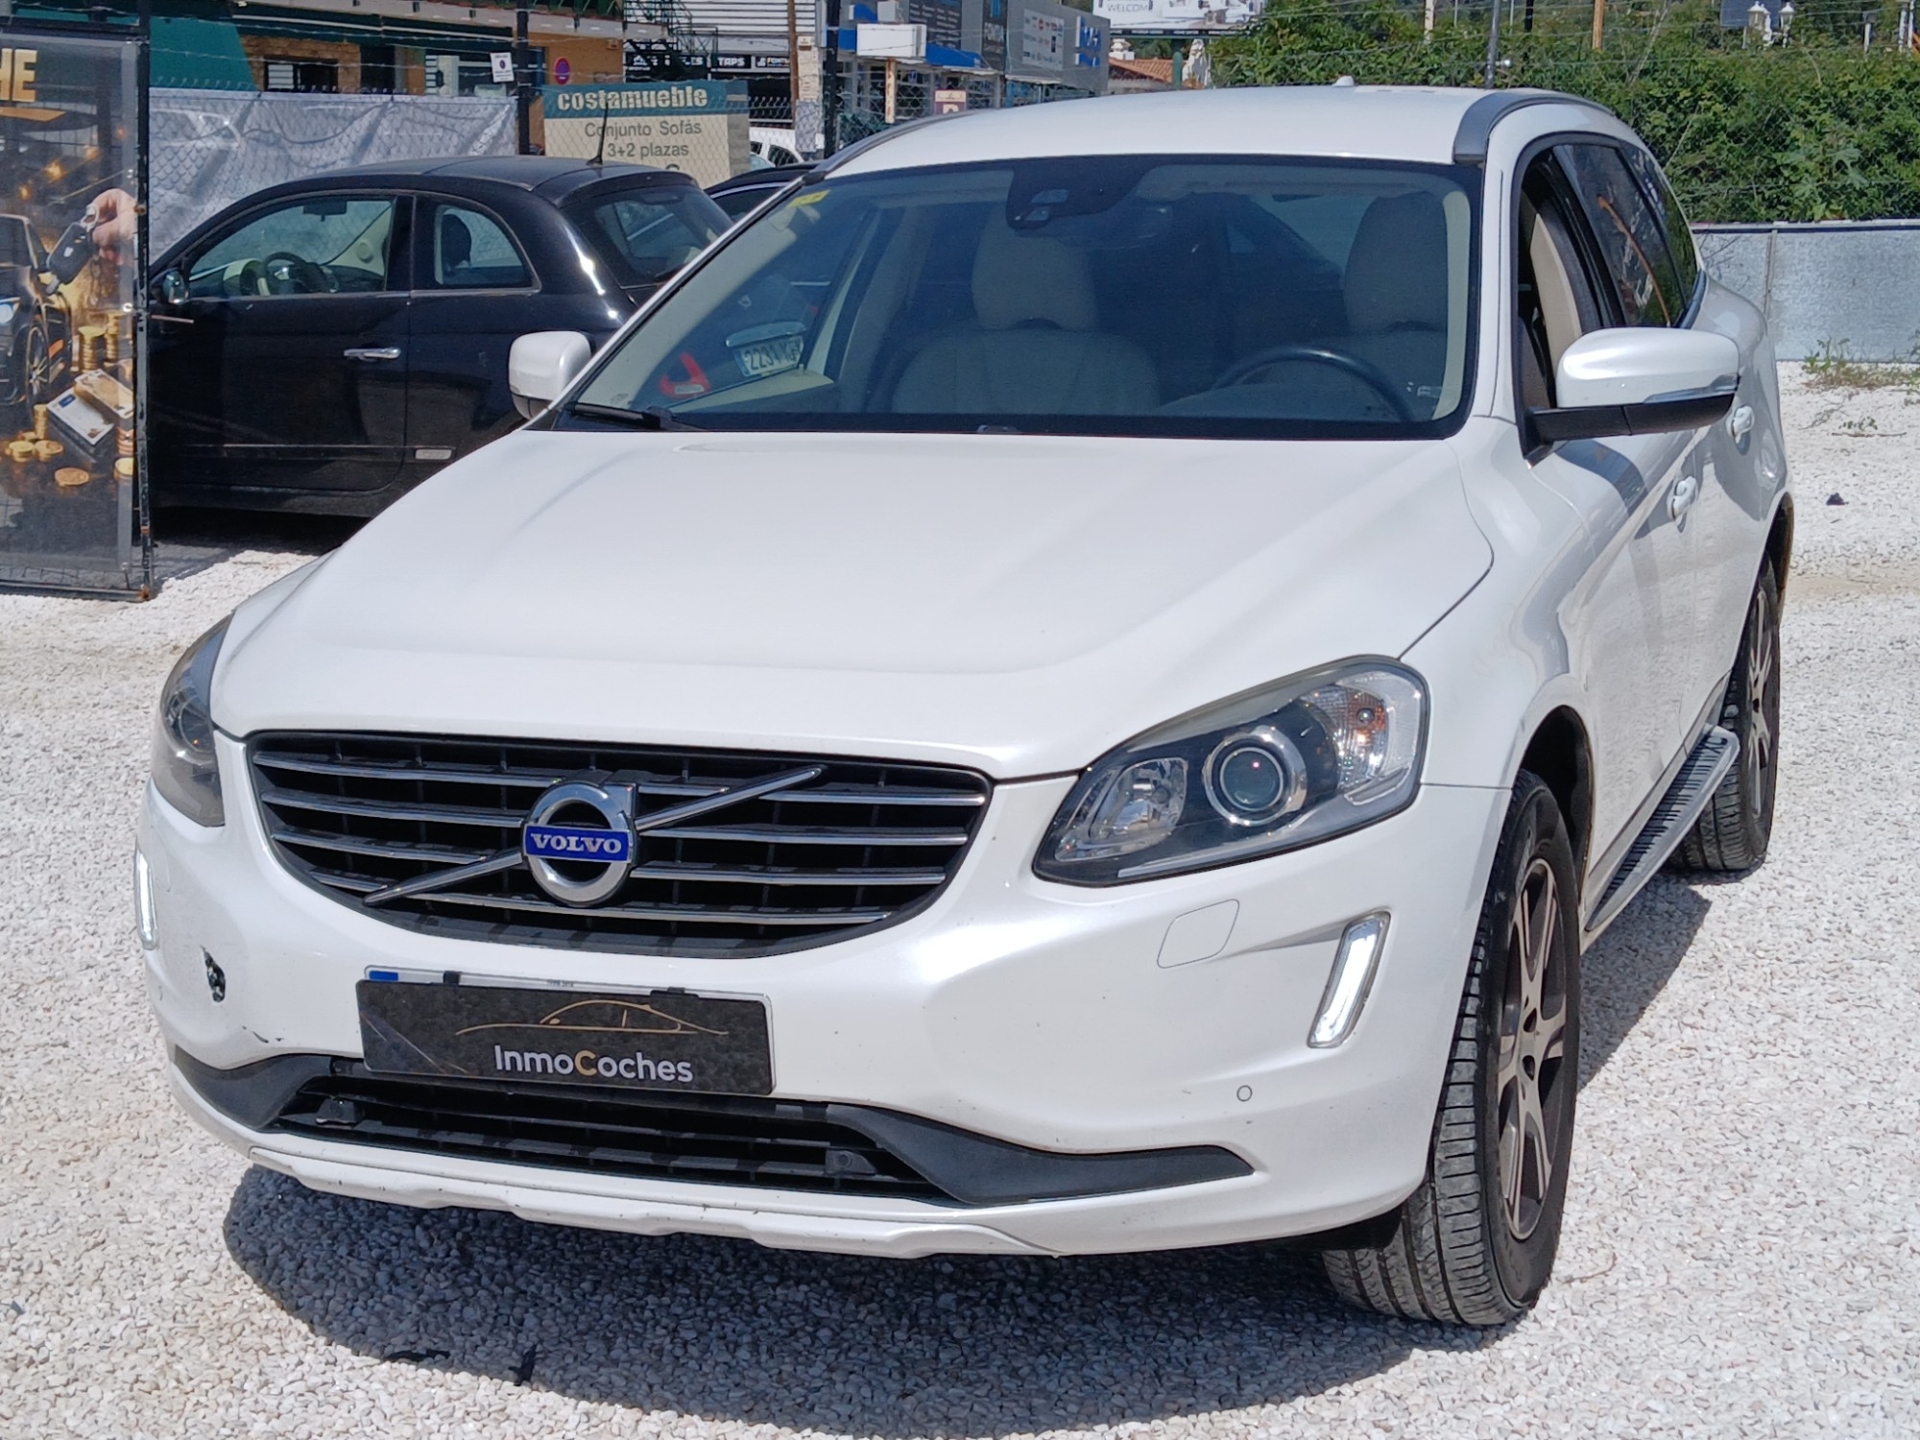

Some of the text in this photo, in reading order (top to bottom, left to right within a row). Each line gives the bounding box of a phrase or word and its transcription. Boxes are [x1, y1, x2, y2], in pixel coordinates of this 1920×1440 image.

[1107, 3, 1152, 13] WELCOM
[557, 86, 708, 110] costamueble
[584, 120, 702, 140] Conjunto Sofás
[607, 142, 689, 160] 3+2 plazas
[530, 833, 622, 854] VOLVO
[494, 1045, 694, 1083] InmoCoches
